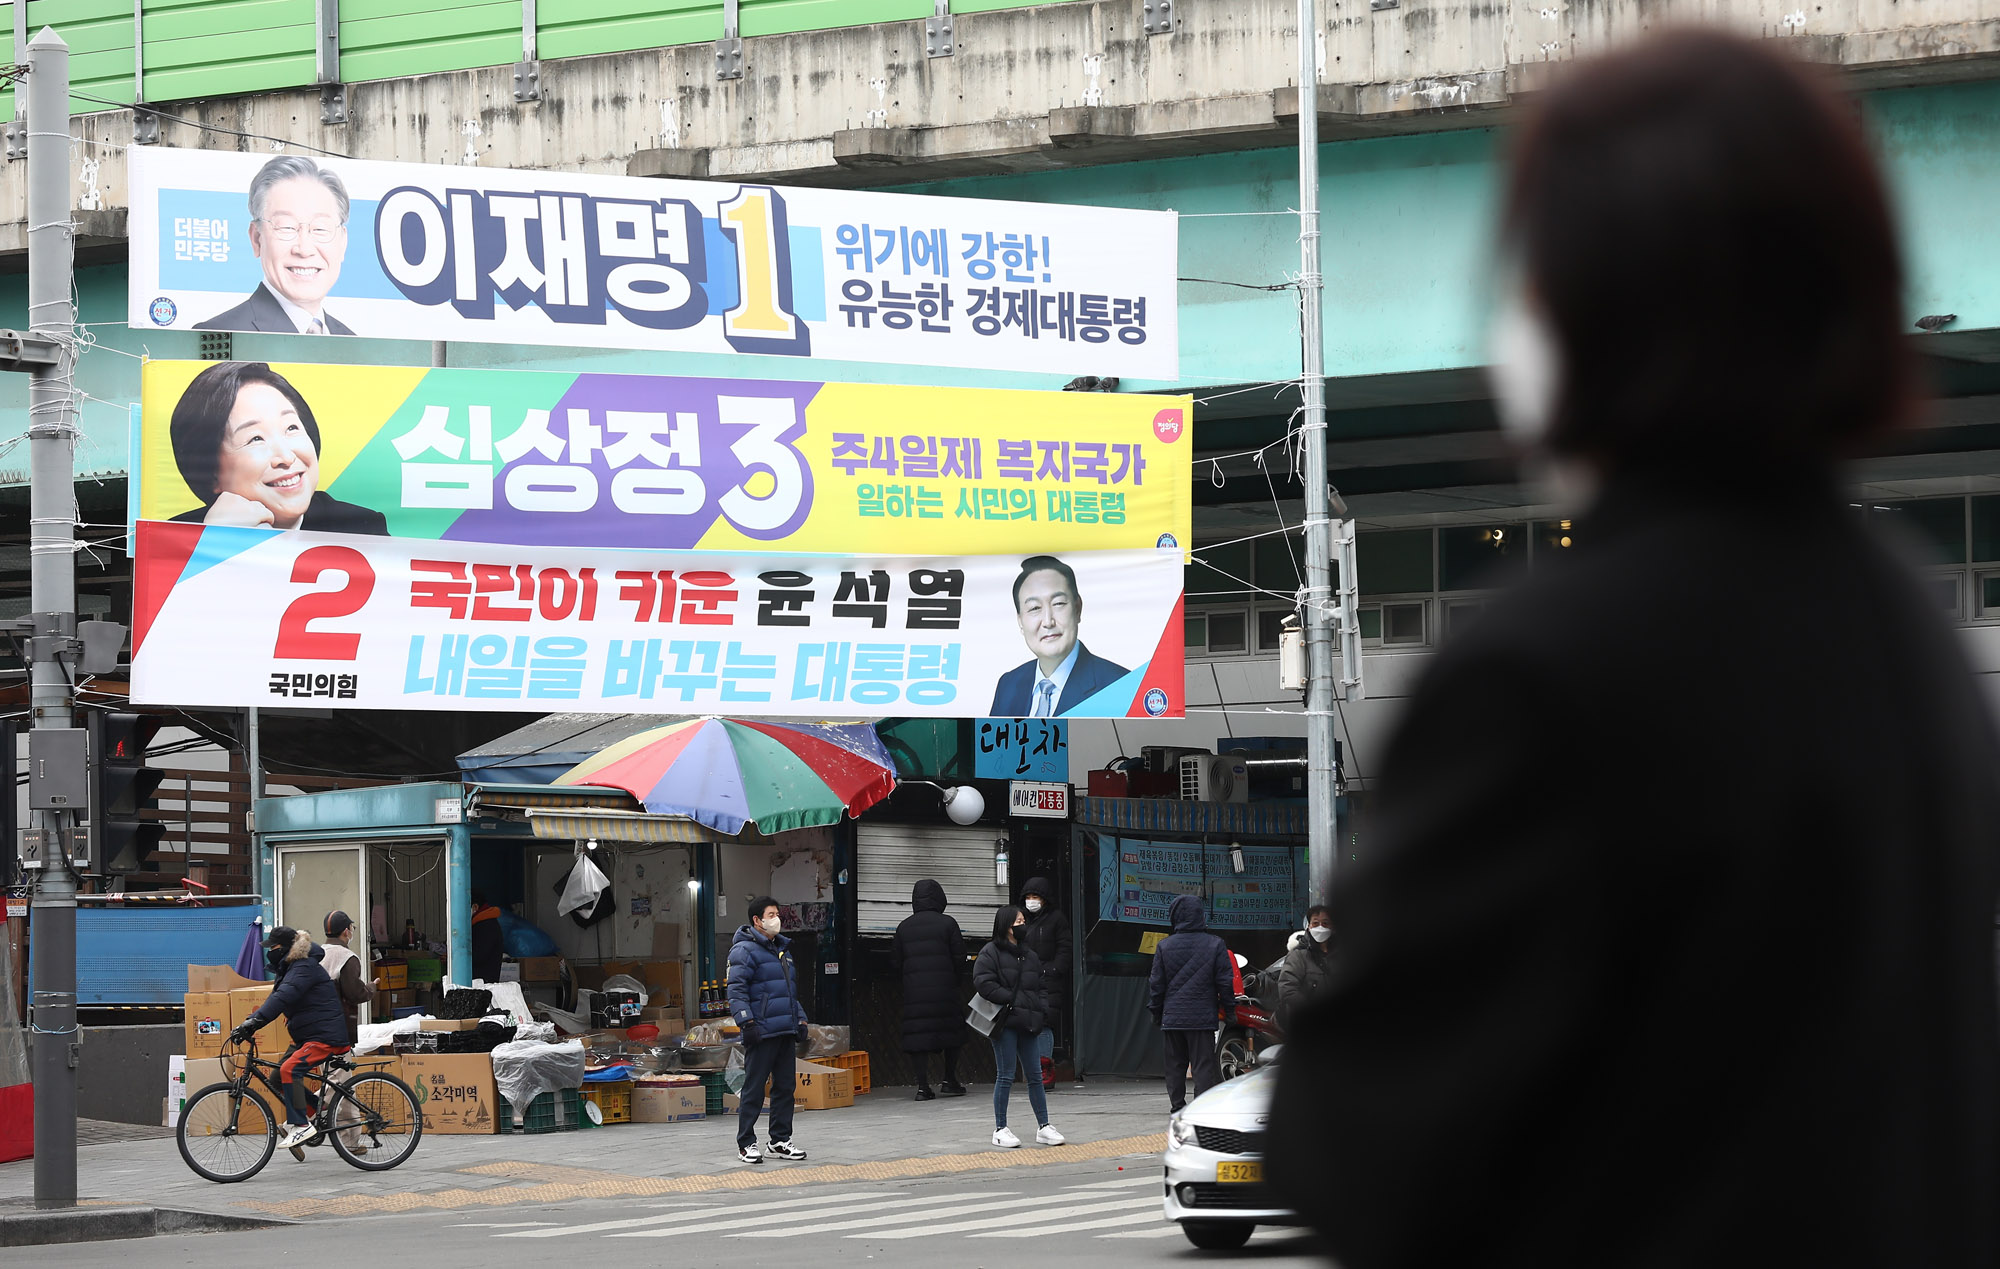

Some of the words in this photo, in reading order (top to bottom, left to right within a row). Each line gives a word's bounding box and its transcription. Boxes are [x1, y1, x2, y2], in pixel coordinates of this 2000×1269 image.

[175, 217, 229, 241] 더불어
[175, 239, 230, 263] 민주당
[374, 185, 707, 330] 이재명
[835, 223, 949, 277] 위기에
[961, 231, 1052, 284] 강한!
[718, 185, 811, 356] 1
[839, 279, 954, 334] 유능한
[966, 287, 1147, 346] 경제대통령
[1157, 422, 1179, 434] 정의당
[391, 404, 707, 516] 심상정
[717, 394, 803, 530] 3
[831, 432, 982, 480] 주4일제
[997, 438, 1146, 487] 복지국가
[856, 483, 945, 519] 일하는
[955, 487, 1038, 522] 시민의
[1047, 489, 1127, 525] 대통령
[273, 545, 376, 662] 2
[410, 559, 598, 623] 국민이
[615, 569, 738, 626] 키운
[268, 673, 358, 699] 국민의힘
[403, 633, 588, 700] 내일을
[601, 639, 777, 703] 바꾸는
[791, 642, 962, 706] 대통령
[1013, 789, 1037, 808] 에어컨
[1039, 790, 1064, 809] 가동중
[431, 1085, 478, 1103] 소각미역
